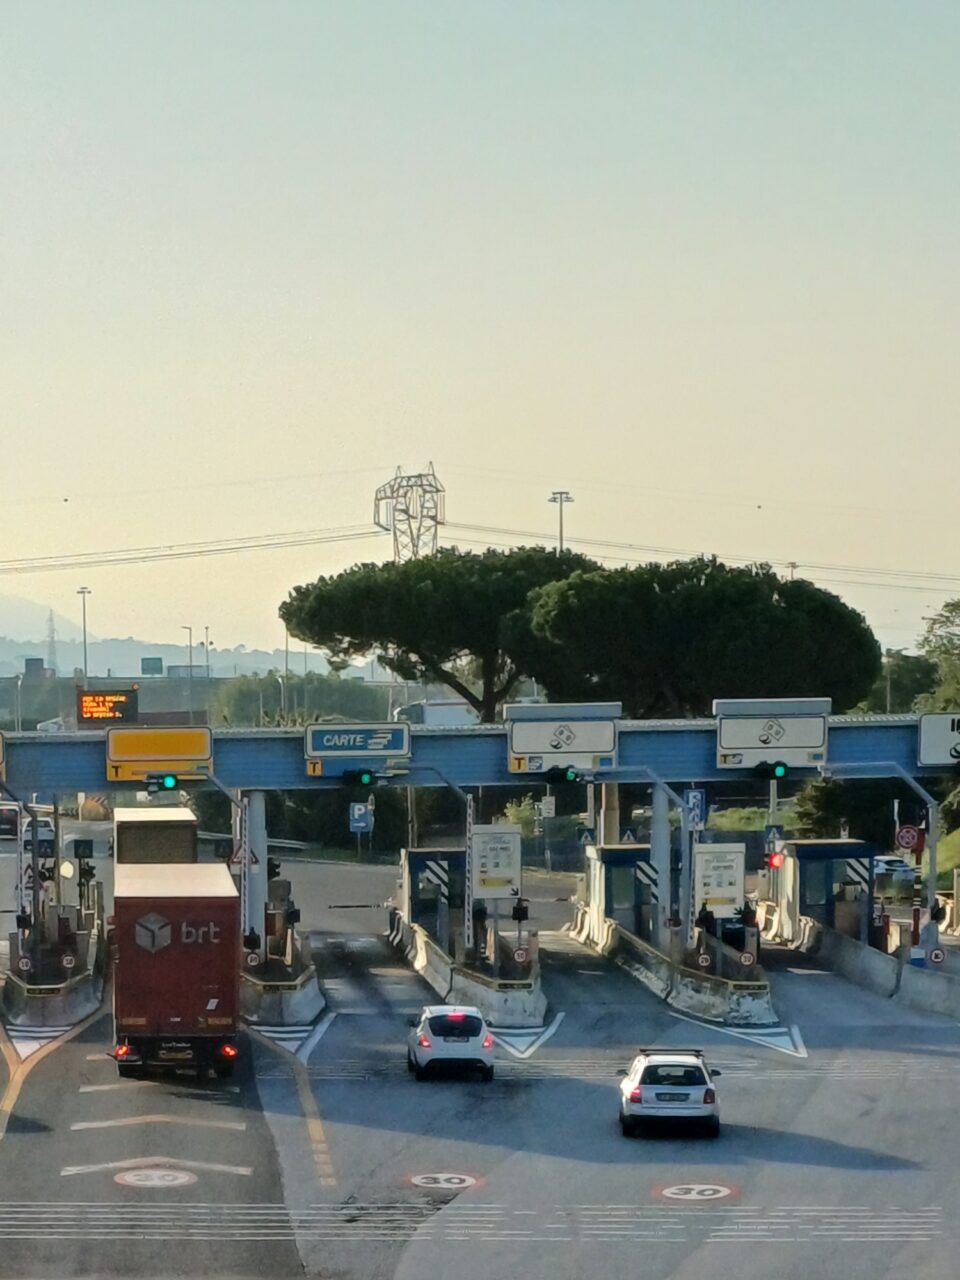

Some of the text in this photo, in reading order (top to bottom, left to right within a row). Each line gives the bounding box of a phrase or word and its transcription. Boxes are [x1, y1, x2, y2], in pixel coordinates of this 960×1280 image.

[323, 734, 365, 747] CARTE
[309, 761, 320, 775] T
[514, 757, 525, 770] T
[112, 765, 121, 778] T
[354, 805, 366, 819] P
[181, 922, 221, 944] brt
[132, 1173, 180, 1183] 30
[420, 1175, 466, 1185] 30
[670, 1187, 722, 1197] 30
